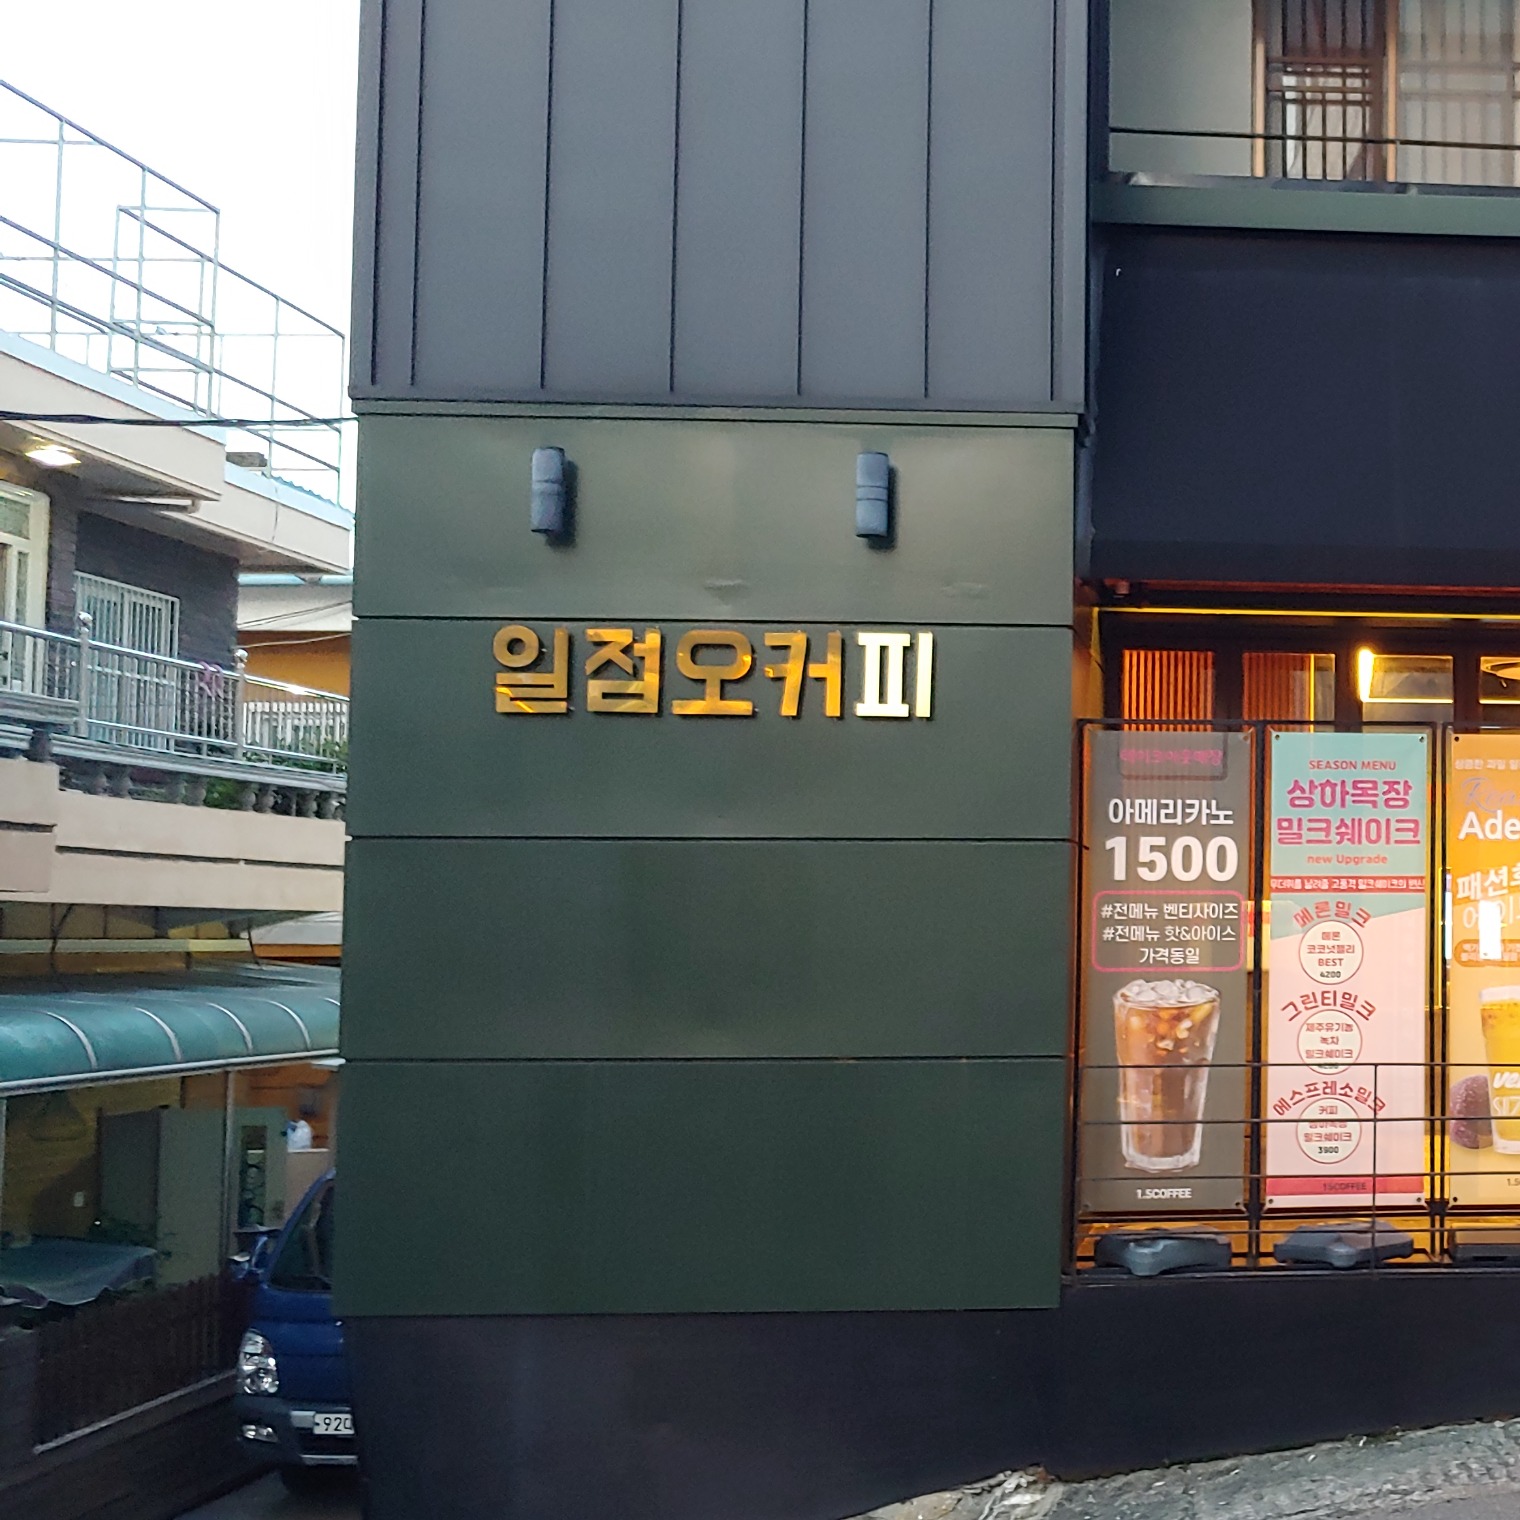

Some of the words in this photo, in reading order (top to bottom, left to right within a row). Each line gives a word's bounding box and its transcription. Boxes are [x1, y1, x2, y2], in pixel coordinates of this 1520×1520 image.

[493, 624, 934, 719] 일점오커피
[1309, 760, 1357, 770] SEASON
[1361, 760, 1396, 770] MENU
[1287, 778, 1413, 810] 상하목장
[1108, 798, 1234, 825] 아메리카노
[1276, 817, 1421, 846] 밀크쉐이크
[1104, 836, 1239, 882] 1500
[1307, 855, 1333, 864] new
[1336, 854, 1388, 866] Upgrade
[1100, 902, 1159, 920] #전메뉴
[1163, 902, 1239, 920] 벤티사이즈
[1102, 925, 1161, 942] #전메뉴
[1165, 925, 1236, 942] 핫&아이스
[1139, 947, 1200, 965] 가격동일
[1318, 958, 1344, 966] BEST
[1281, 990, 1376, 1022] 그린티밀크
[1273, 1081, 1386, 1116] 에스프레소밀크
[1318, 1105, 1338, 1115] 커피
[1136, 1188, 1192, 1199] 1.5COFFEE
